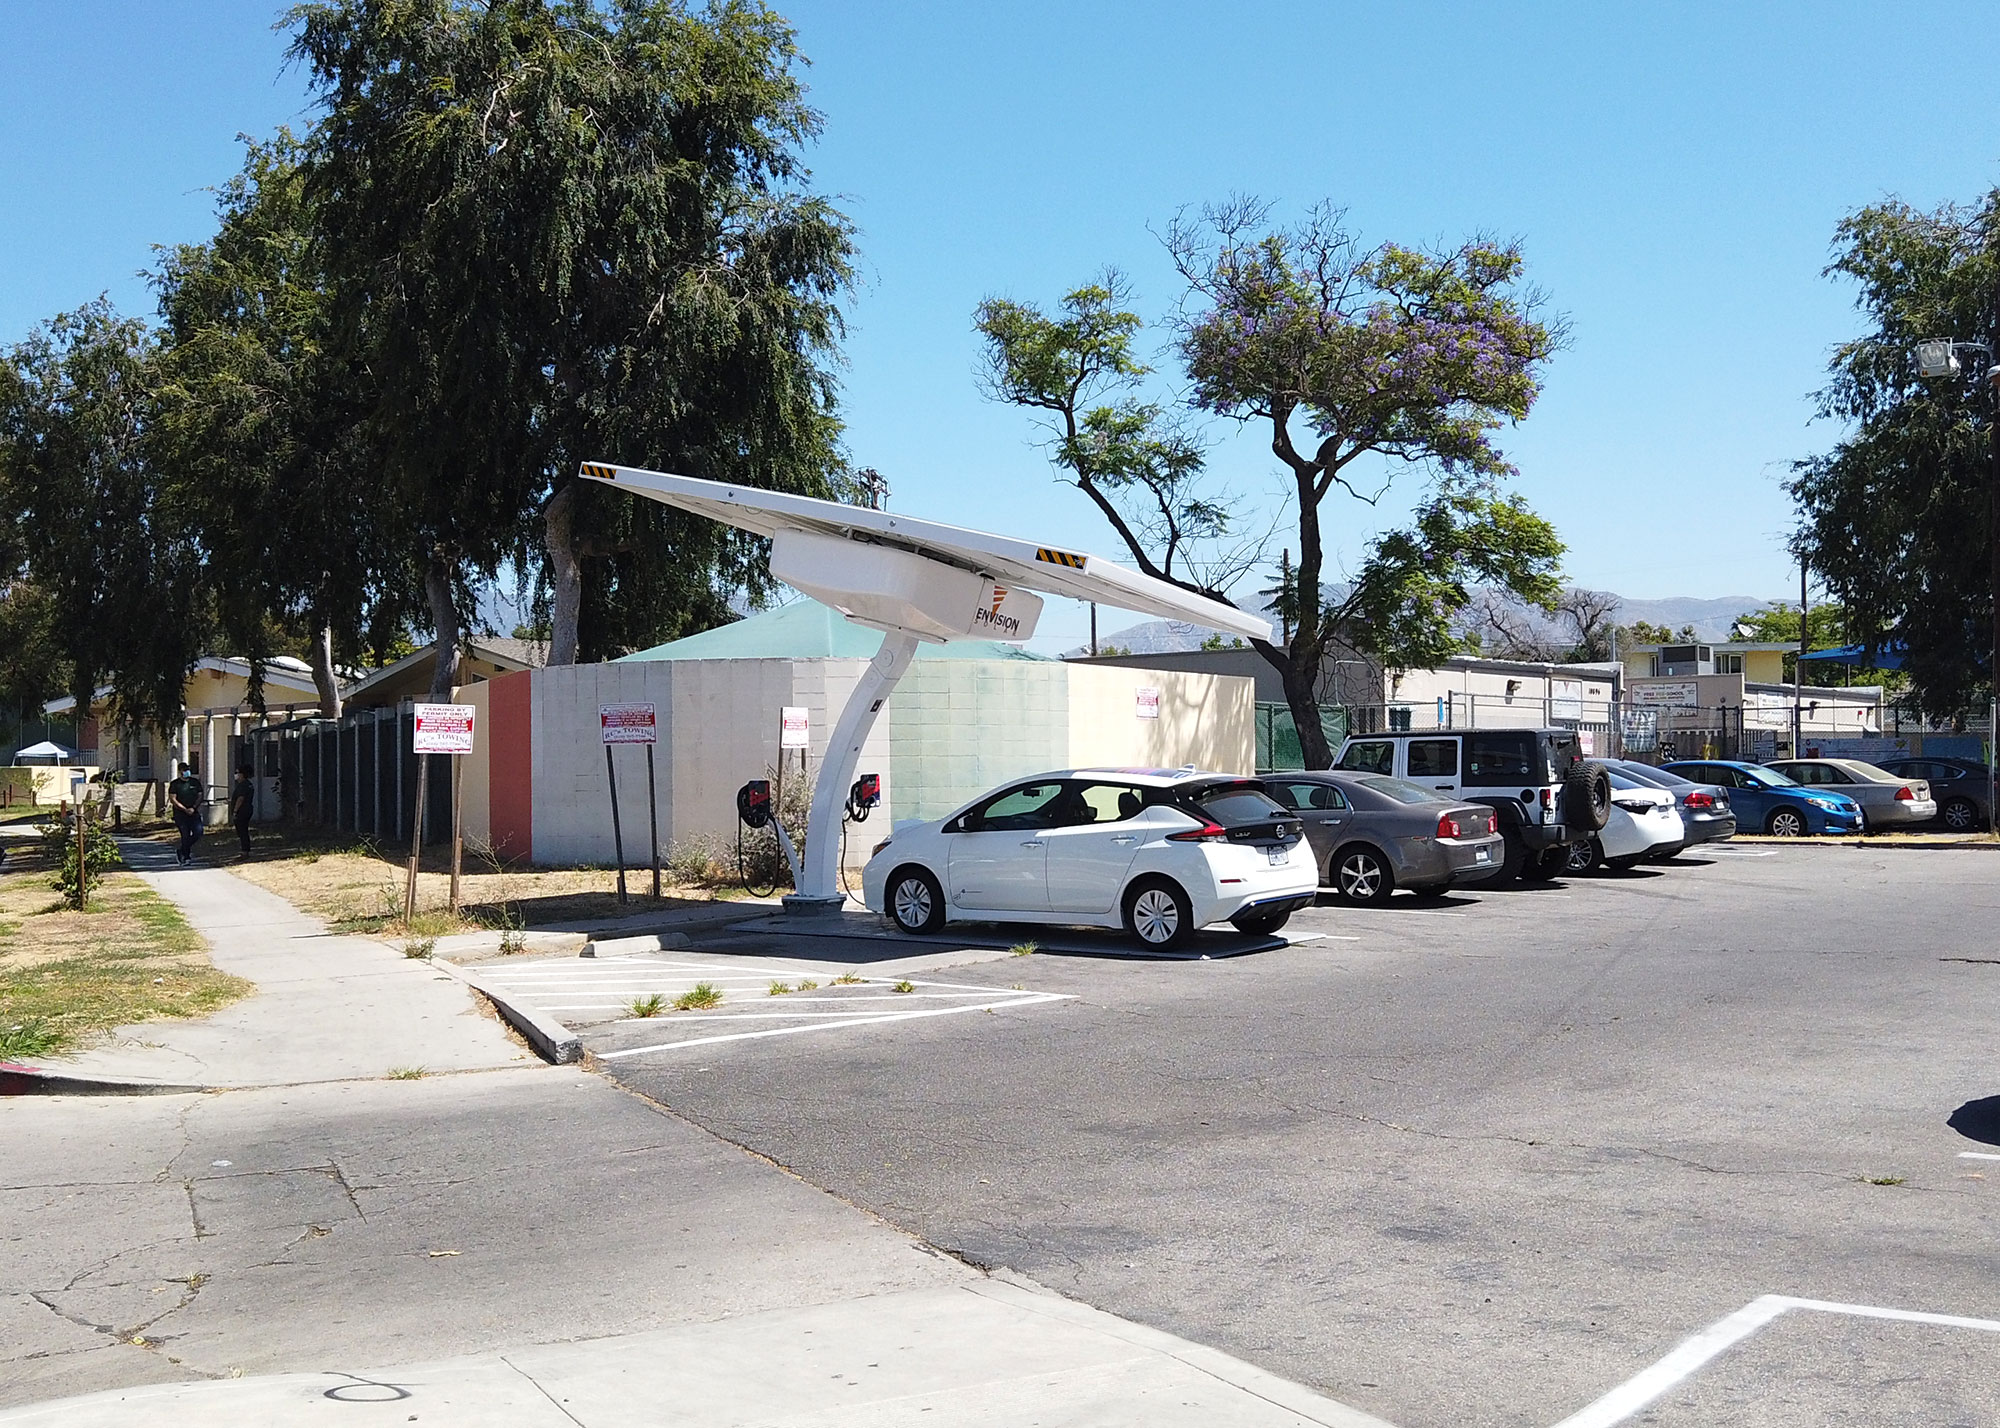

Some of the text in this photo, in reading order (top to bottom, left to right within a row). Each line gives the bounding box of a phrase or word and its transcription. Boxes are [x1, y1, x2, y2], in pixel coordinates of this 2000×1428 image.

[976, 607, 1020, 631] ENVISION
[973, 618, 1017, 636] SOLAR
[437, 734, 471, 746] TOWING
[623, 727, 655, 738] TOWING
